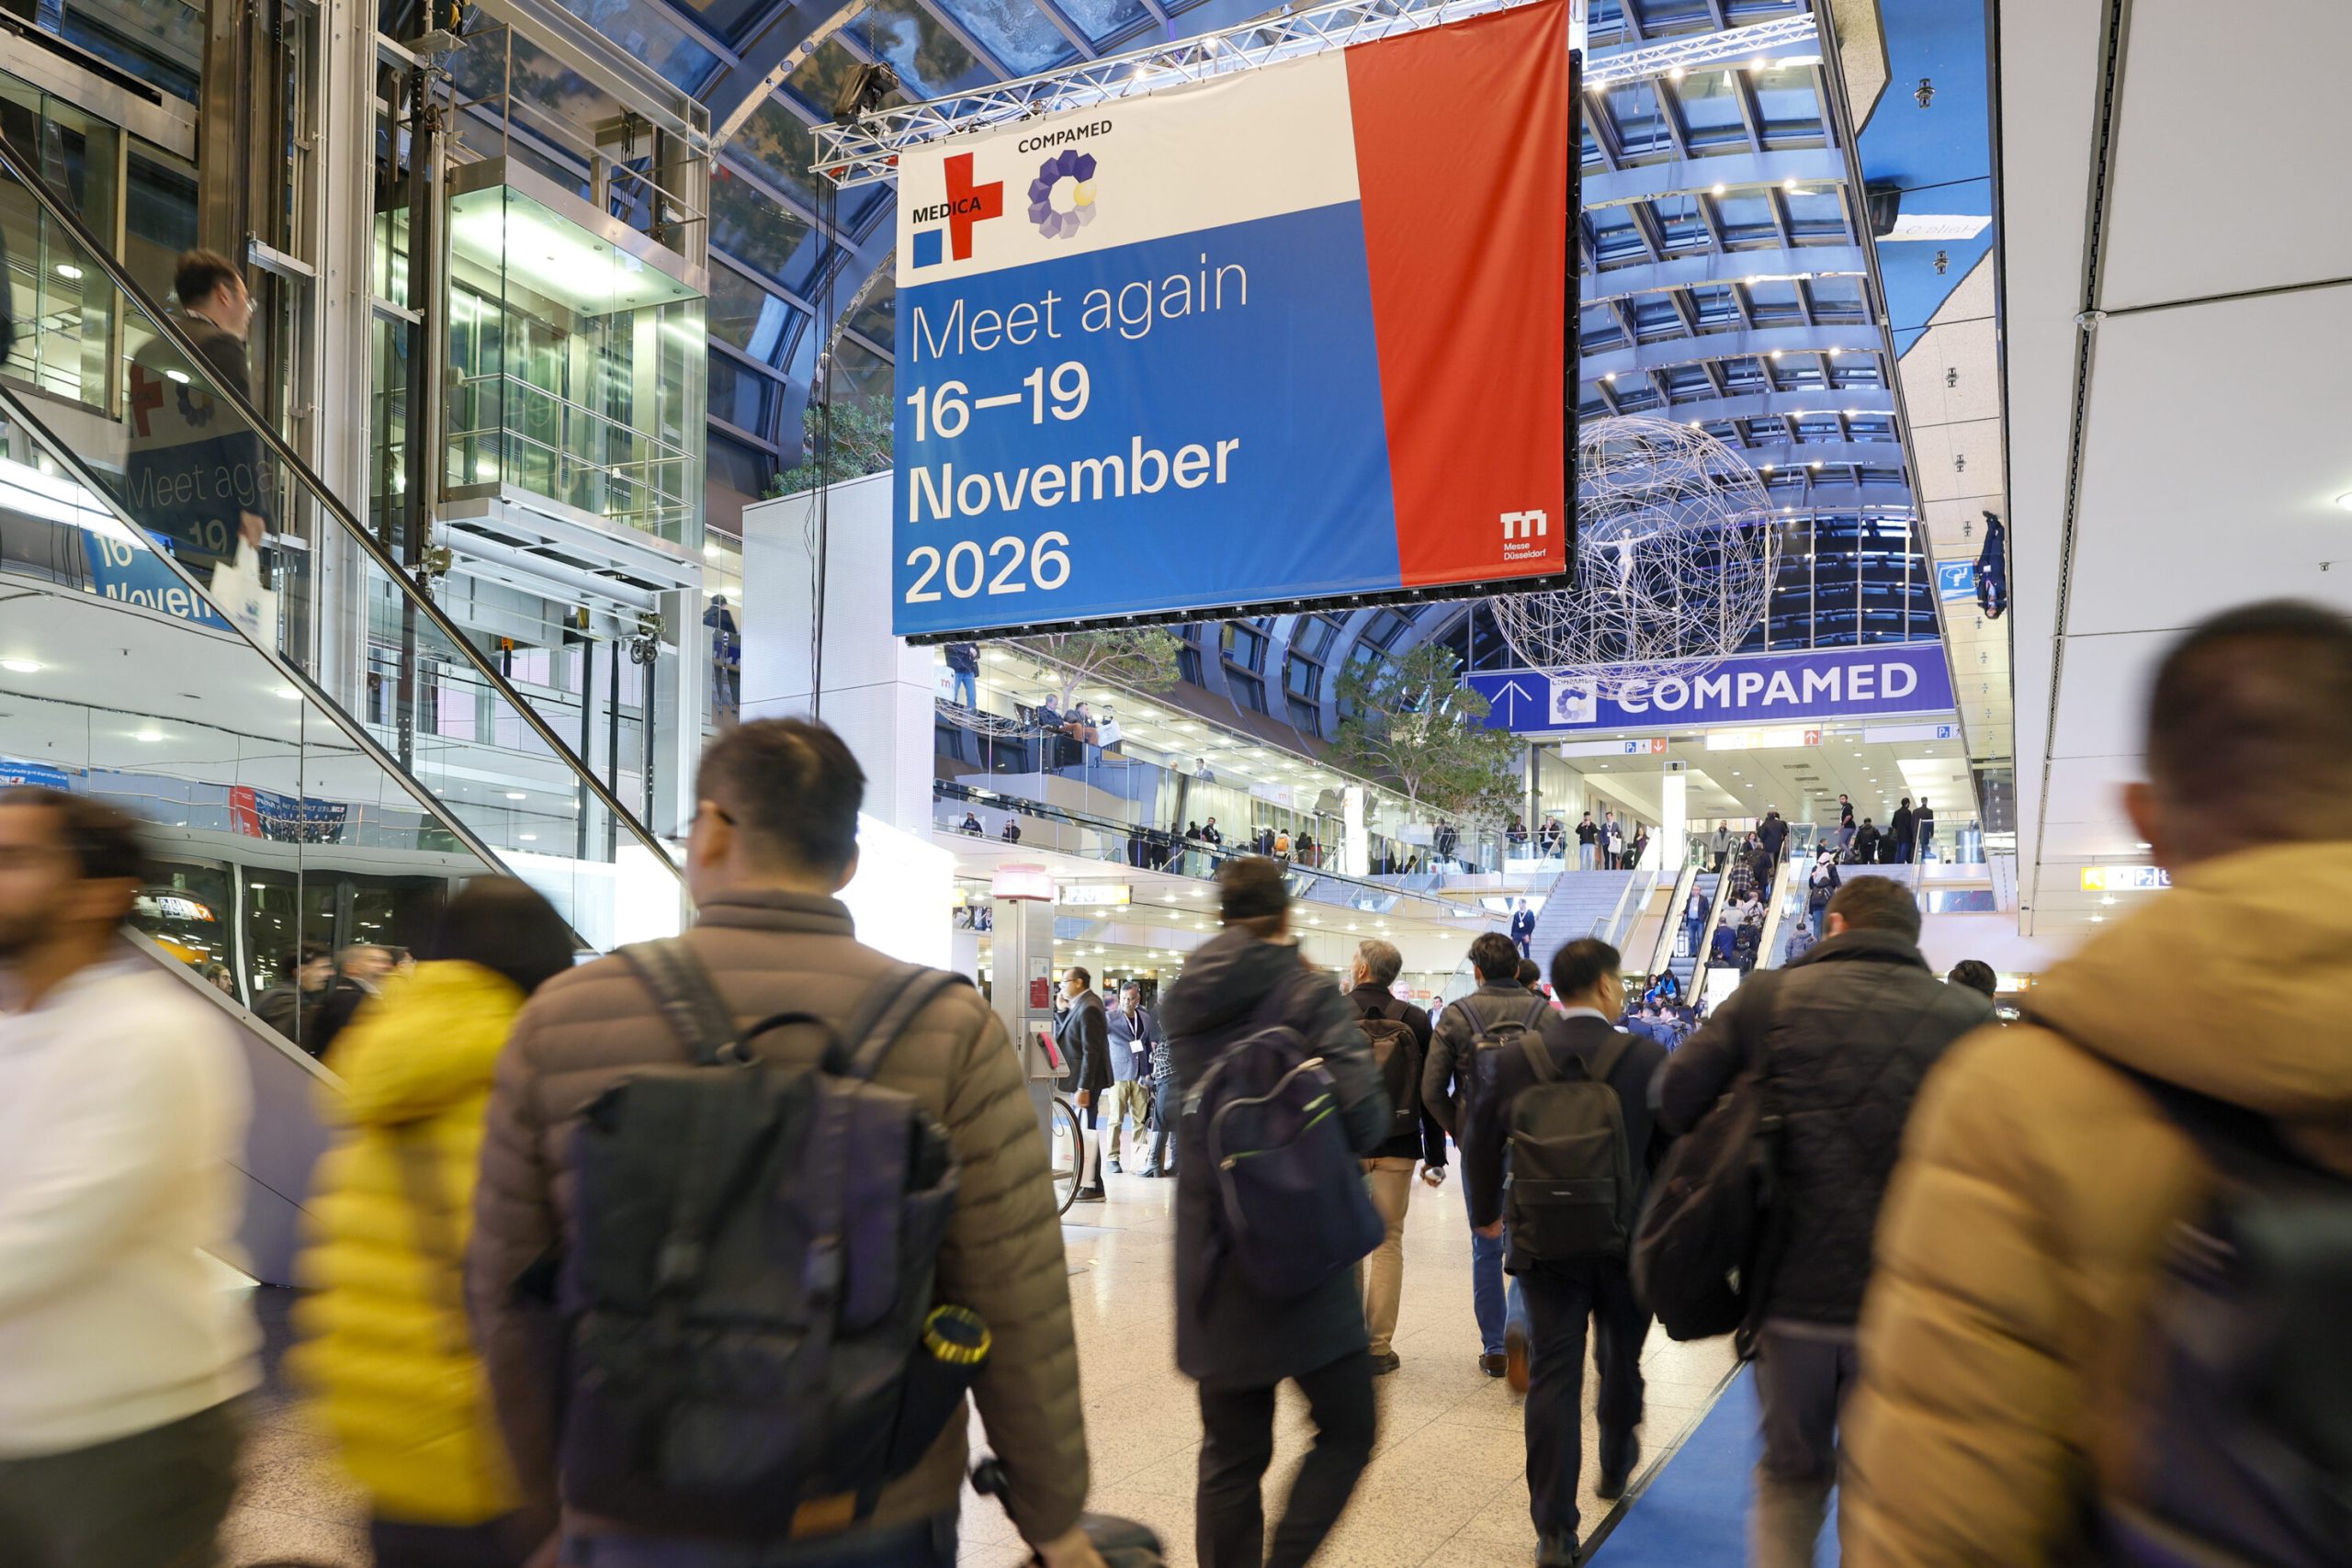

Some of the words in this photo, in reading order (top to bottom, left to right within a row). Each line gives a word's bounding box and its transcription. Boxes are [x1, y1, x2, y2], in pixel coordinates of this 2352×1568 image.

[1018, 120, 1113, 153] COMPAMED
[912, 197, 982, 224] MEDICA
[913, 289, 1062, 363] Meet
[1081, 253, 1247, 340] again
[125, 464, 207, 510] Meet
[909, 435, 1239, 523] November
[905, 530, 1070, 604] 2026
[1504, 542, 1531, 551] Messe
[1504, 548, 1546, 561] Düsseldorf
[1617, 662, 1918, 714] COMPAMED
